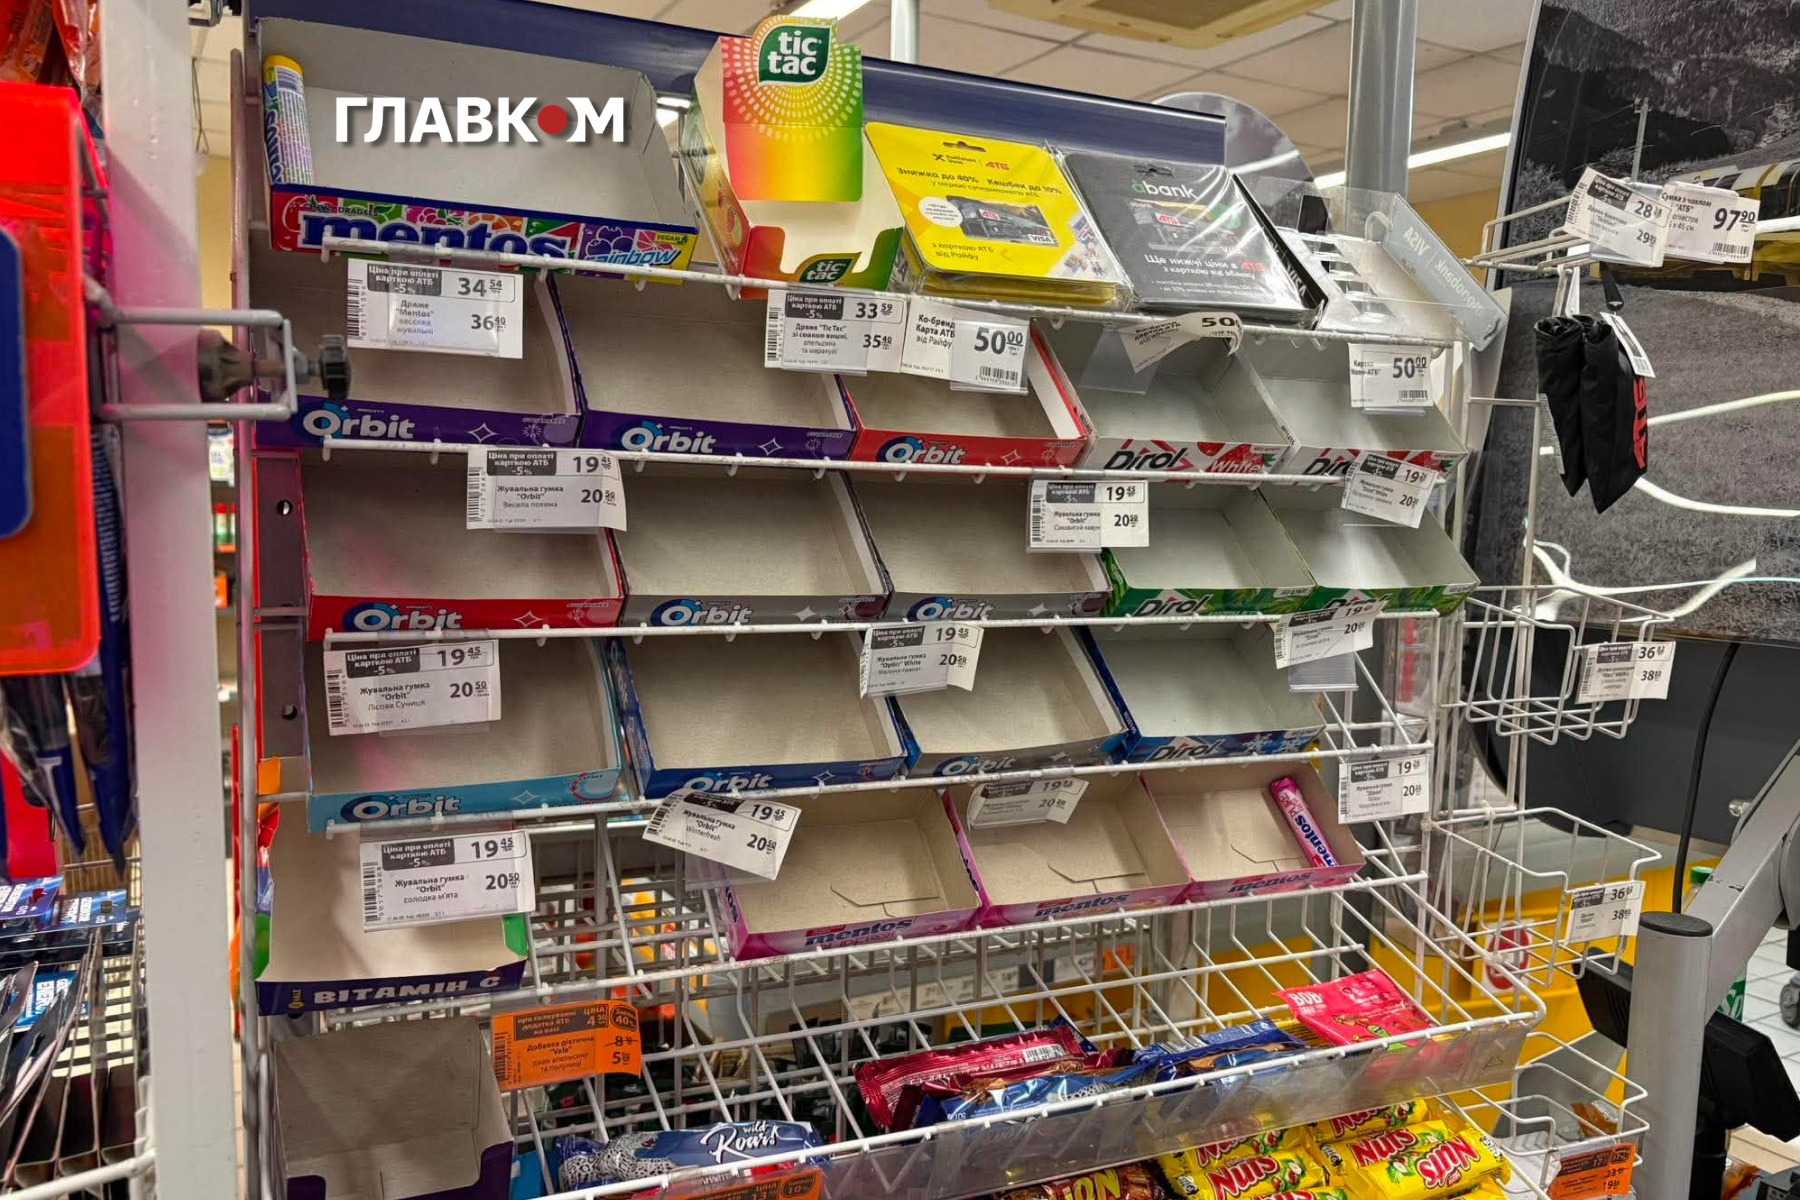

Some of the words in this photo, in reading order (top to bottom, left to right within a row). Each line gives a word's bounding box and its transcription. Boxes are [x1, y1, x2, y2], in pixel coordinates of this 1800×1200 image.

[779, 31, 818, 56] tic
[768, 51, 817, 75] tac
[1662, 192, 1682, 203] Сумка
[302, 215, 572, 261] mentos
[657, 234, 680, 242] VEGAN
[1031, 235, 1053, 243] VISA
[1144, 254, 1167, 265] Ще
[369, 265, 389, 275] Ціна
[391, 268, 408, 277] при
[410, 269, 439, 279] оплаті
[817, 261, 842, 273] tic
[376, 275, 414, 285] карткою
[417, 277, 433, 285] АТБ
[806, 270, 838, 282] tac
[401, 300, 429, 309] Драже
[918, 314, 956, 328] Ко-бренд
[915, 324, 938, 335] Карта
[940, 328, 956, 338] АТБ
[916, 335, 927, 343] від
[928, 335, 953, 349] Райфу
[303, 410, 415, 439] Orbit
[621, 427, 716, 454] Orbit
[488, 452, 508, 460] Ціна
[886, 443, 966, 464] Orbit
[1103, 448, 1189, 471] Dirol
[1210, 460, 1263, 473] White
[497, 486, 539, 496] Жувальна
[916, 602, 994, 621] Orbit
[1131, 594, 1212, 617] Dirol
[353, 608, 463, 629] Orbit
[661, 604, 753, 625] Orbit
[347, 654, 367, 662] Ціна
[369, 653, 386, 661] при
[388, 650, 417, 658] оплаті
[354, 660, 393, 668] карткою
[360, 685, 404, 695] Жувальна
[405, 682, 430, 691] гумка
[381, 692, 410, 701] "Orbit"
[368, 703, 394, 712] Лісова
[395, 700, 426, 710] Суниця
[1145, 740, 1226, 762] Dirol
[942, 756, 1017, 775] Orbit
[682, 773, 773, 793] Orbit
[352, 795, 462, 820] Orbit
[683, 809, 716, 823] Жувальна
[717, 819, 735, 830] гумка
[695, 819, 719, 832] "Orbit"
[686, 825, 721, 842] Winterfresh
[383, 845, 404, 853] Ціна
[423, 841, 451, 849] оплаті
[1295, 815, 1337, 867] mentos
[390, 851, 428, 860] карткою
[430, 848, 446, 856] АТБ
[395, 878, 438, 888] Жувальна
[440, 874, 465, 883] гумка
[1229, 870, 1313, 893] mentos
[416, 884, 445, 893] "Orbit"
[404, 894, 436, 904] солодка
[1034, 894, 1129, 917] mentos
[804, 919, 914, 946] mentos
[313, 979, 471, 1005] ВІТАМІН
[1288, 992, 1323, 1005] BOB
[584, 1008, 605, 1016] ЦІНА
[527, 1041, 559, 1052] Добавка
[742, 1121, 767, 1134] wild
[1348, 1128, 1418, 1168] Nuts
[1416, 1135, 1481, 1190] Nuts
[1205, 1155, 1279, 1200] Nuts
